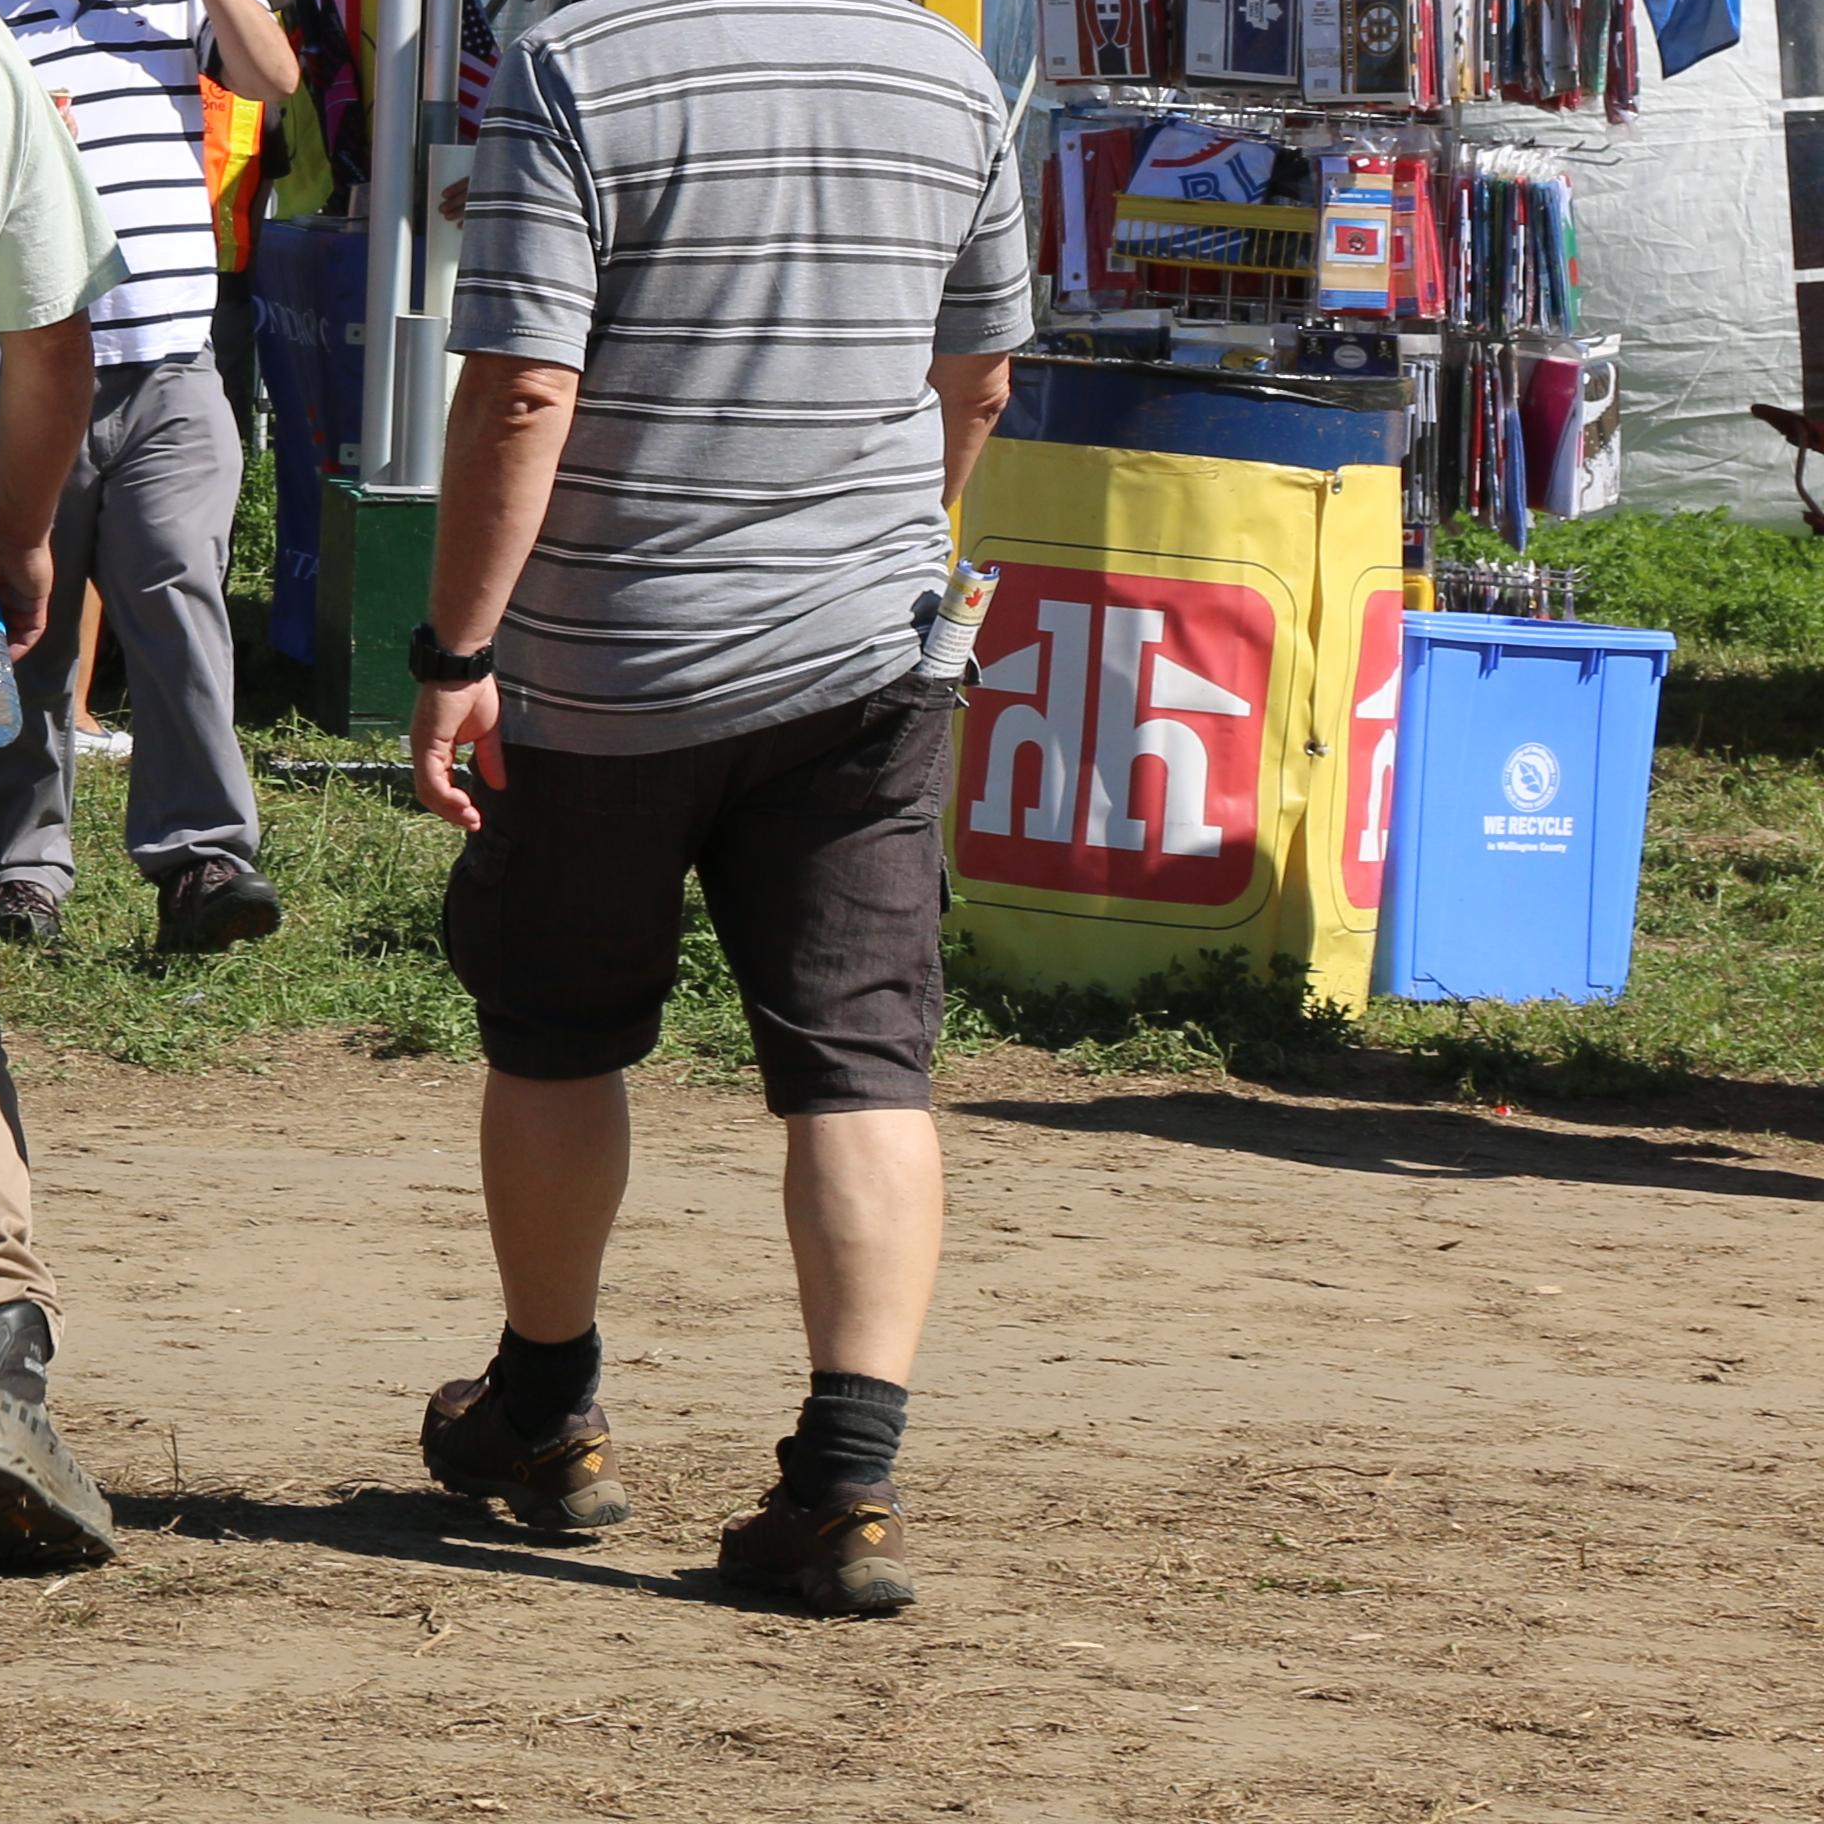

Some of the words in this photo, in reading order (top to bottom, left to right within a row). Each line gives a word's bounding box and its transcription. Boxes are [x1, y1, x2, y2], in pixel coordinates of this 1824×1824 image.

[1483, 816, 1506, 835] WE
[1508, 816, 1574, 836] RECYCLE
[1540, 842, 1567, 854] County
